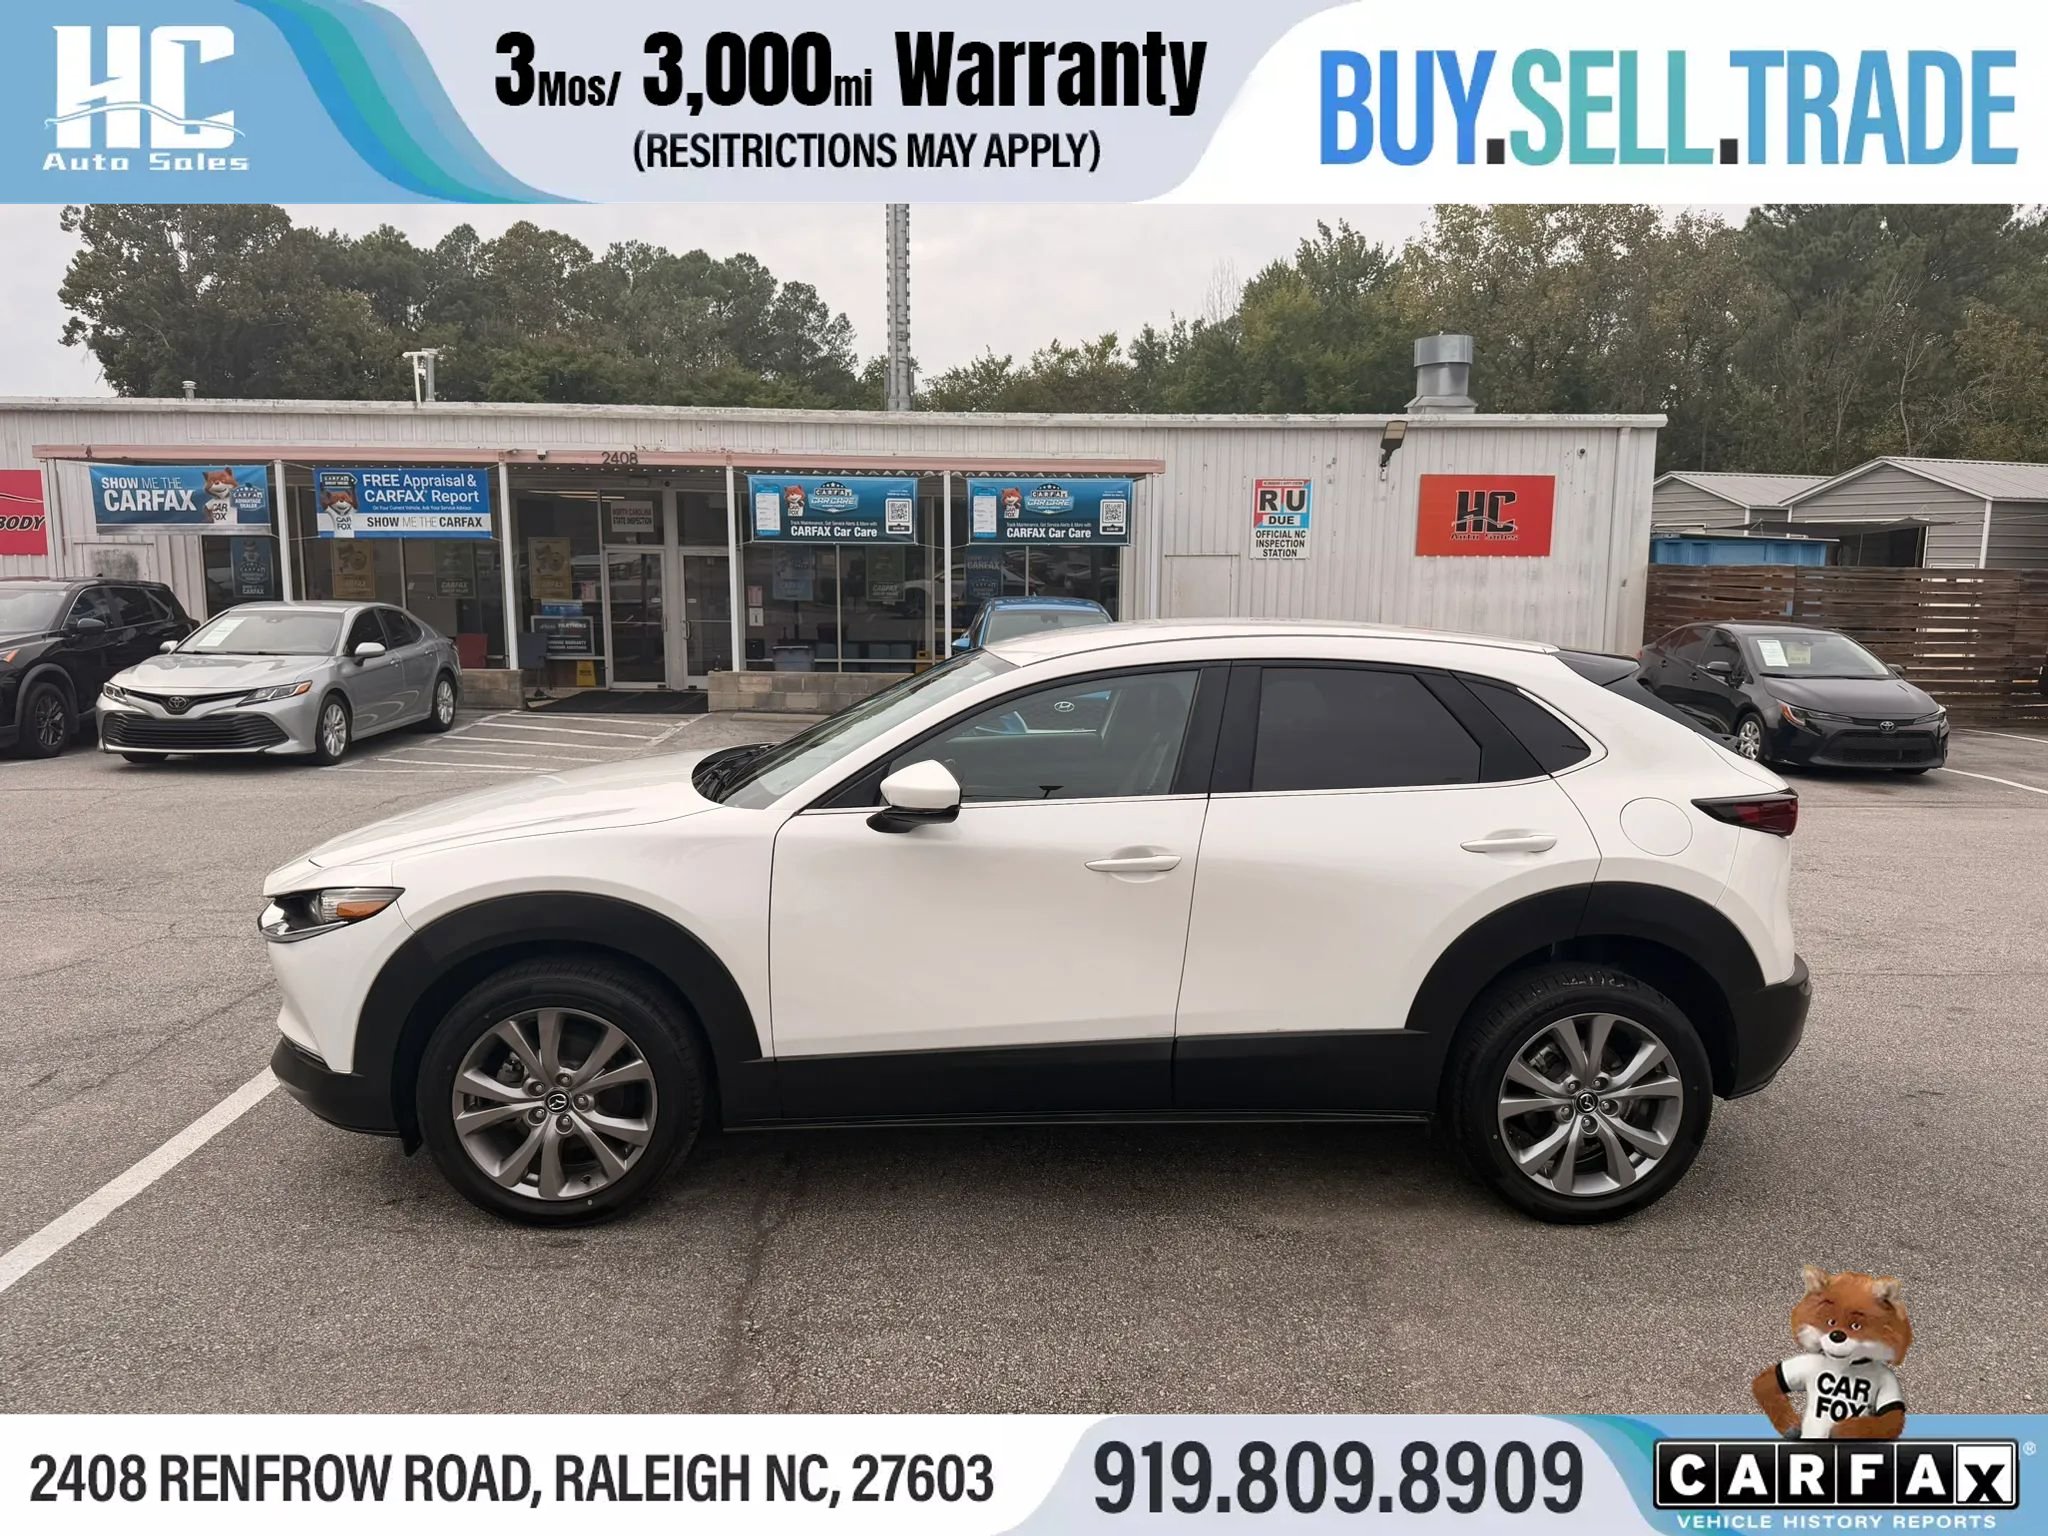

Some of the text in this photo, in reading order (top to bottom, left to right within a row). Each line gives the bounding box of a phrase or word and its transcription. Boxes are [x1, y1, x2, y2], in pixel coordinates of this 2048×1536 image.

[602, 451, 638, 465] 2408
[101, 477, 182, 489] SHOW ME THE
[362, 473, 477, 489] FREE Appraisal &
[103, 489, 197, 512] CARFAX
[431, 489, 480, 506] Report
[1259, 490, 1278, 511] R
[1286, 490, 1306, 511] U
[212, 503, 228, 512] CAR
[1452, 490, 1518, 533] HC
[367, 516, 483, 528] SHOW ME THE CARFAX
[1268, 515, 1295, 525] DUE
[791, 525, 878, 538] CARFAX Car Care
[1006, 527, 1092, 538] CARFAX Car Care
[1255, 530, 1306, 538] OFFICIAL NC
[1255, 539, 1305, 548] INSPECTION
[1262, 548, 1297, 557] STATION
